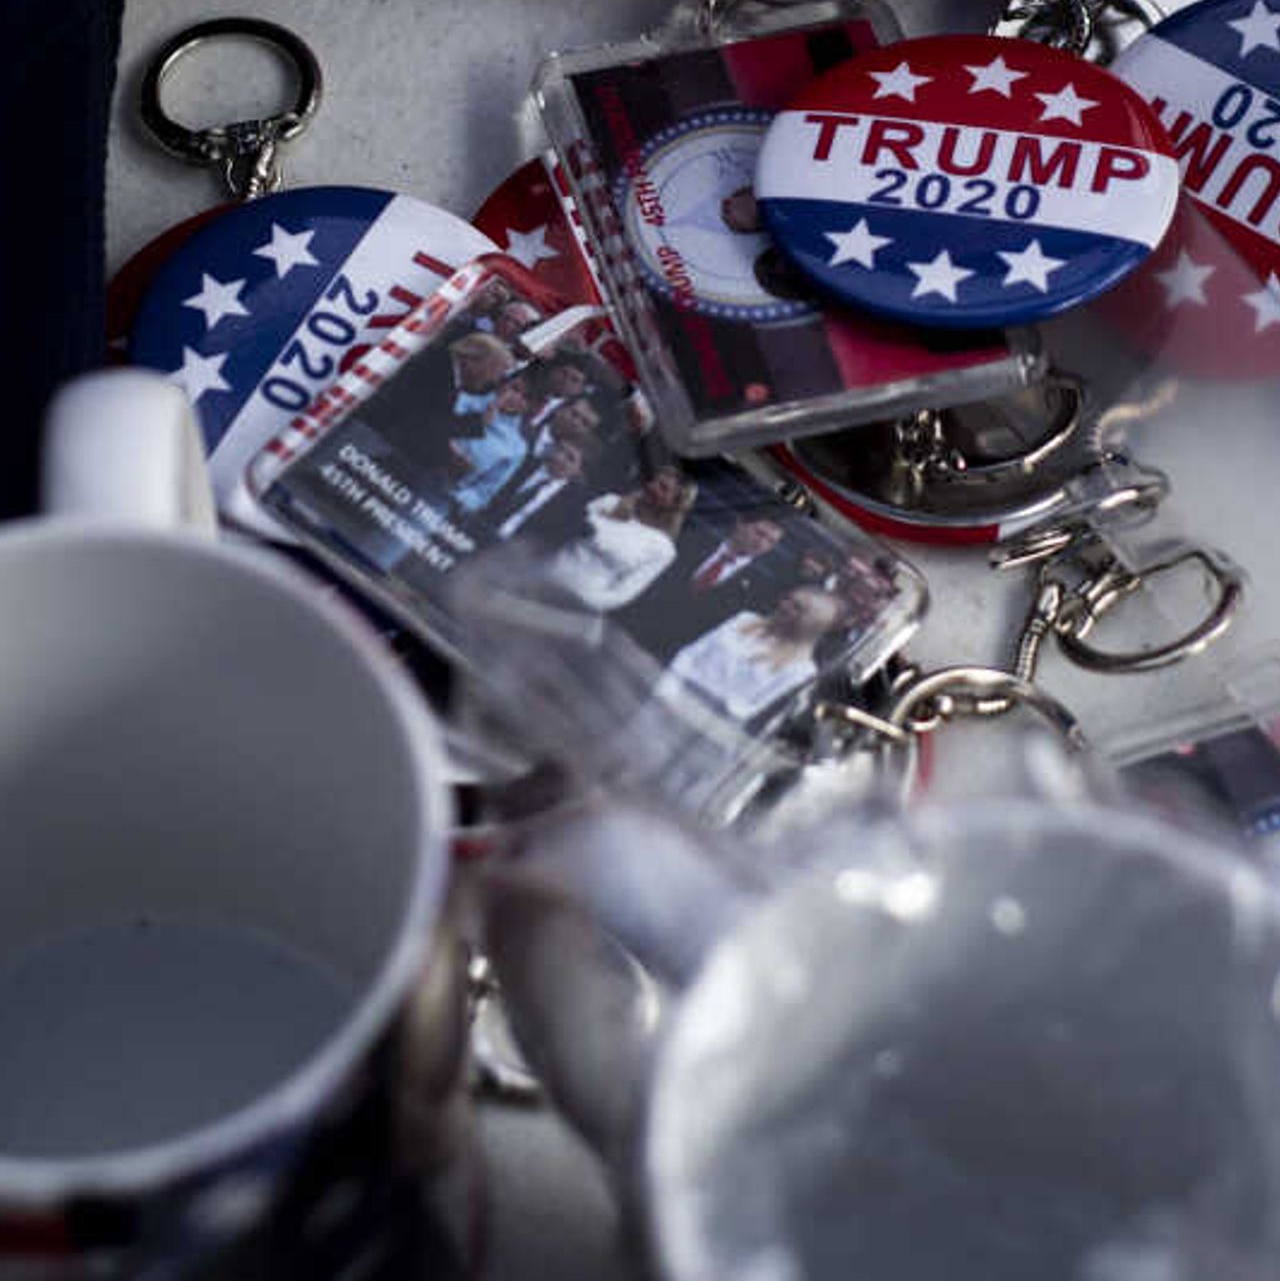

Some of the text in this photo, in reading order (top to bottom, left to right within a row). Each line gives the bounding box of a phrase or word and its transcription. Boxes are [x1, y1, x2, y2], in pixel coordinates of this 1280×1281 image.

[804, 114, 1151, 194] TRUMP
[867, 169, 1041, 219] 2020
[261, 275, 380, 413] 2020
[338, 442, 414, 506] DONALD
